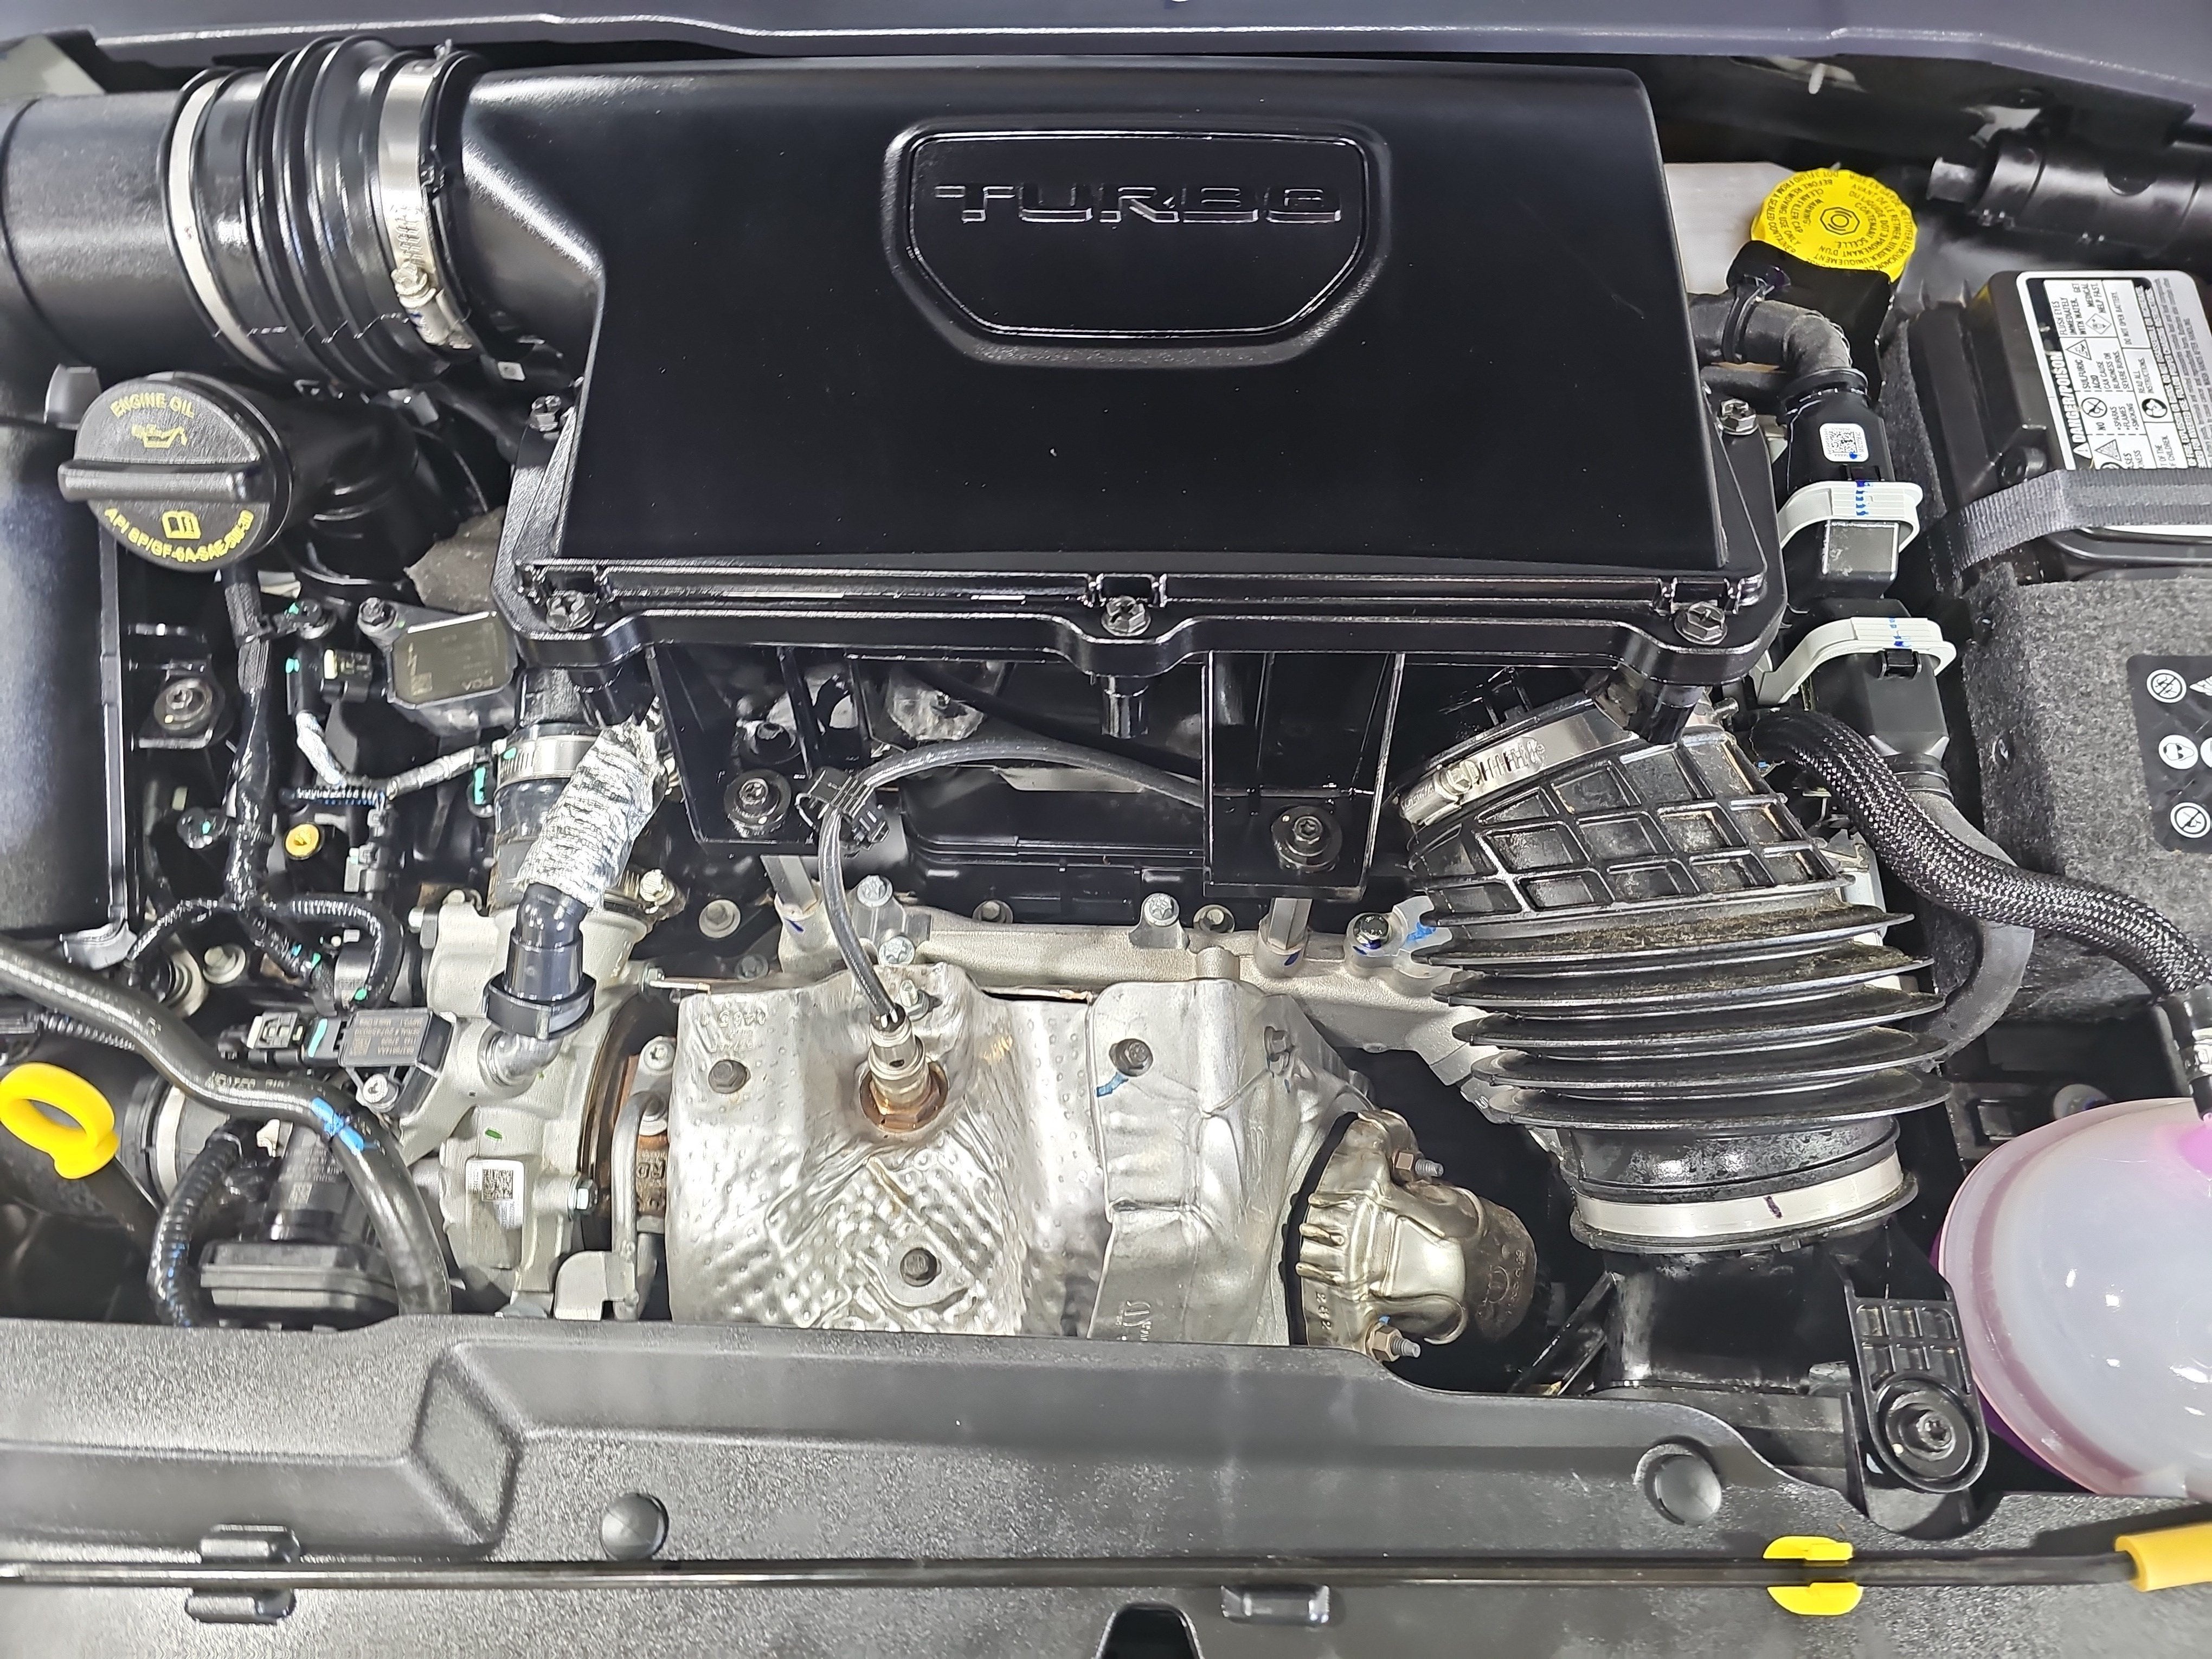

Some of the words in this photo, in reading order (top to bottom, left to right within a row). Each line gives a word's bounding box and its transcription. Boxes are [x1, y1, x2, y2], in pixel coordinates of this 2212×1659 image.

[1801, 179, 1833, 189] BEFORE
[1851, 184, 1877, 196] AVANT
[1800, 188, 1824, 202] CLEAN
[1849, 191, 1860, 199] DU
[935, 185, 1342, 224] TURBO
[1766, 198, 1778, 221] SEALED
[1791, 201, 1804, 220] FILLER
[1779, 217, 1789, 228] USE
[1791, 221, 1803, 233] CAP
[1818, 245, 1838, 256] D'UN
[1814, 254, 1870, 266] UNIQUEMENT
[2072, 283, 2081, 293] GET
[2081, 283, 2095, 307] MEDICAL
[2052, 301, 2062, 314] EYES
[2095, 300, 2106, 313] HELP
[2060, 297, 2077, 335] IMMEDIATELY
[2117, 314, 2126, 326] OPEN
[2056, 318, 2068, 335] FLUSH
[2076, 321, 2087, 335] WITH
[2120, 328, 2129, 337] NOT
[2074, 359, 2091, 389] SULFURIC
[2096, 361, 2107, 377] CAUSE
[2090, 375, 2101, 389] ACID
[2102, 379, 2111, 389] CAN
[2048, 351, 2086, 442] DANGER/POISON
[110, 392, 167, 418] ENGINE
[169, 396, 195, 419] OIL
[2095, 422, 2106, 430] NO
[2155, 445, 2163, 453] THE
[104, 507, 130, 534] API
